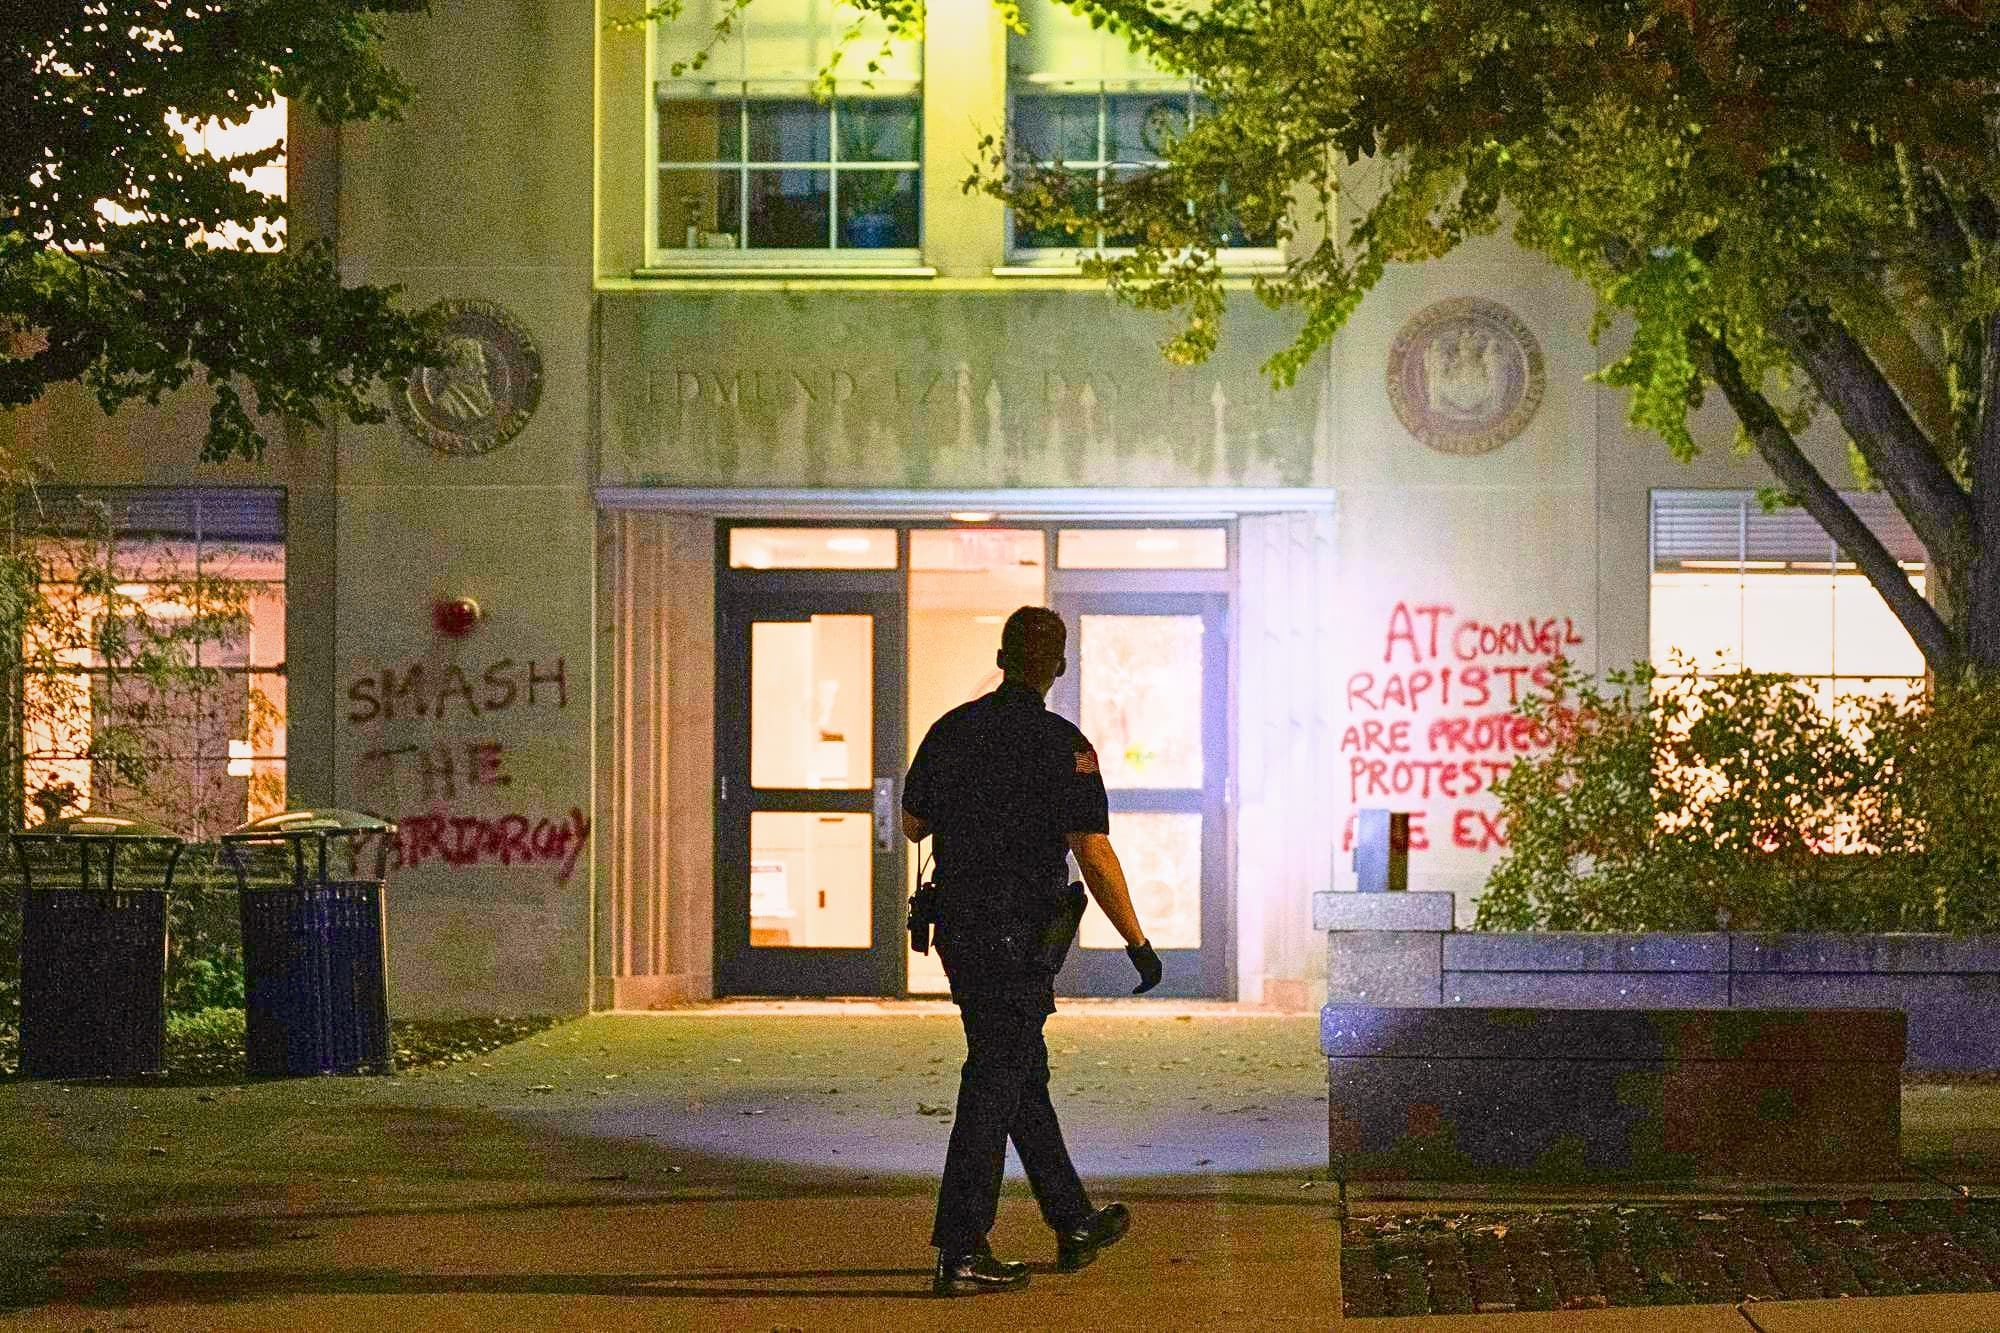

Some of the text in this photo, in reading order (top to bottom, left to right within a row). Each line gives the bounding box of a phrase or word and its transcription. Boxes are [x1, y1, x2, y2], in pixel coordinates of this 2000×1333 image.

[1384, 601, 1453, 662] AT
[348, 657, 567, 723] SMASH
[1341, 720, 1410, 754] ARE
[361, 741, 512, 798] THE
[1350, 756, 1513, 803] PROTEST
